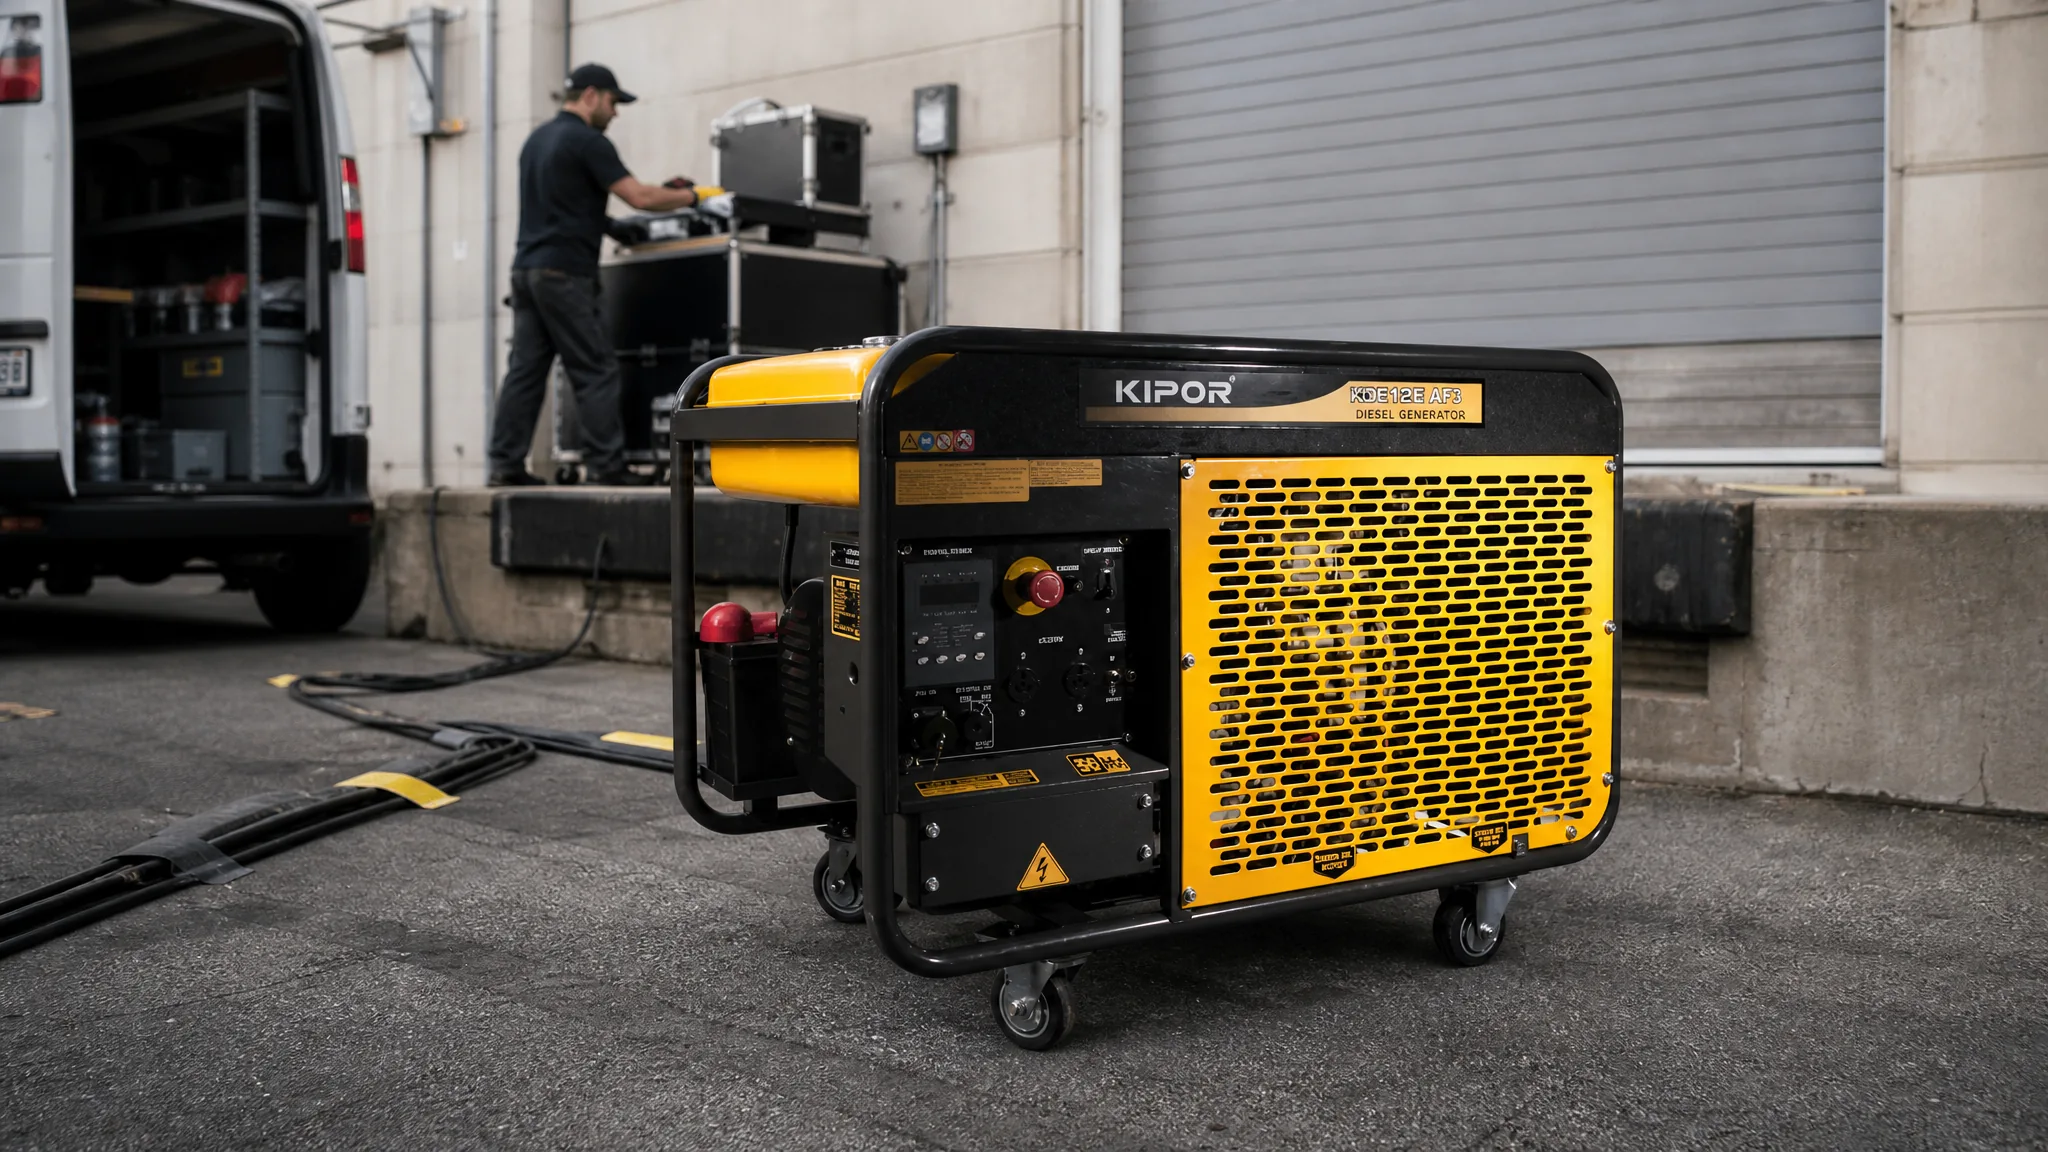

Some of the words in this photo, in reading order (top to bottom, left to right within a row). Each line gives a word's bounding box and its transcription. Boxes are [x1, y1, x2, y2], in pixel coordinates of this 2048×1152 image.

[1115, 379, 1233, 404] KIPOR
[1428, 387, 1463, 404] AF3
[1356, 409, 1394, 420] DIESEL
[1399, 409, 1466, 420] GENERATOR
